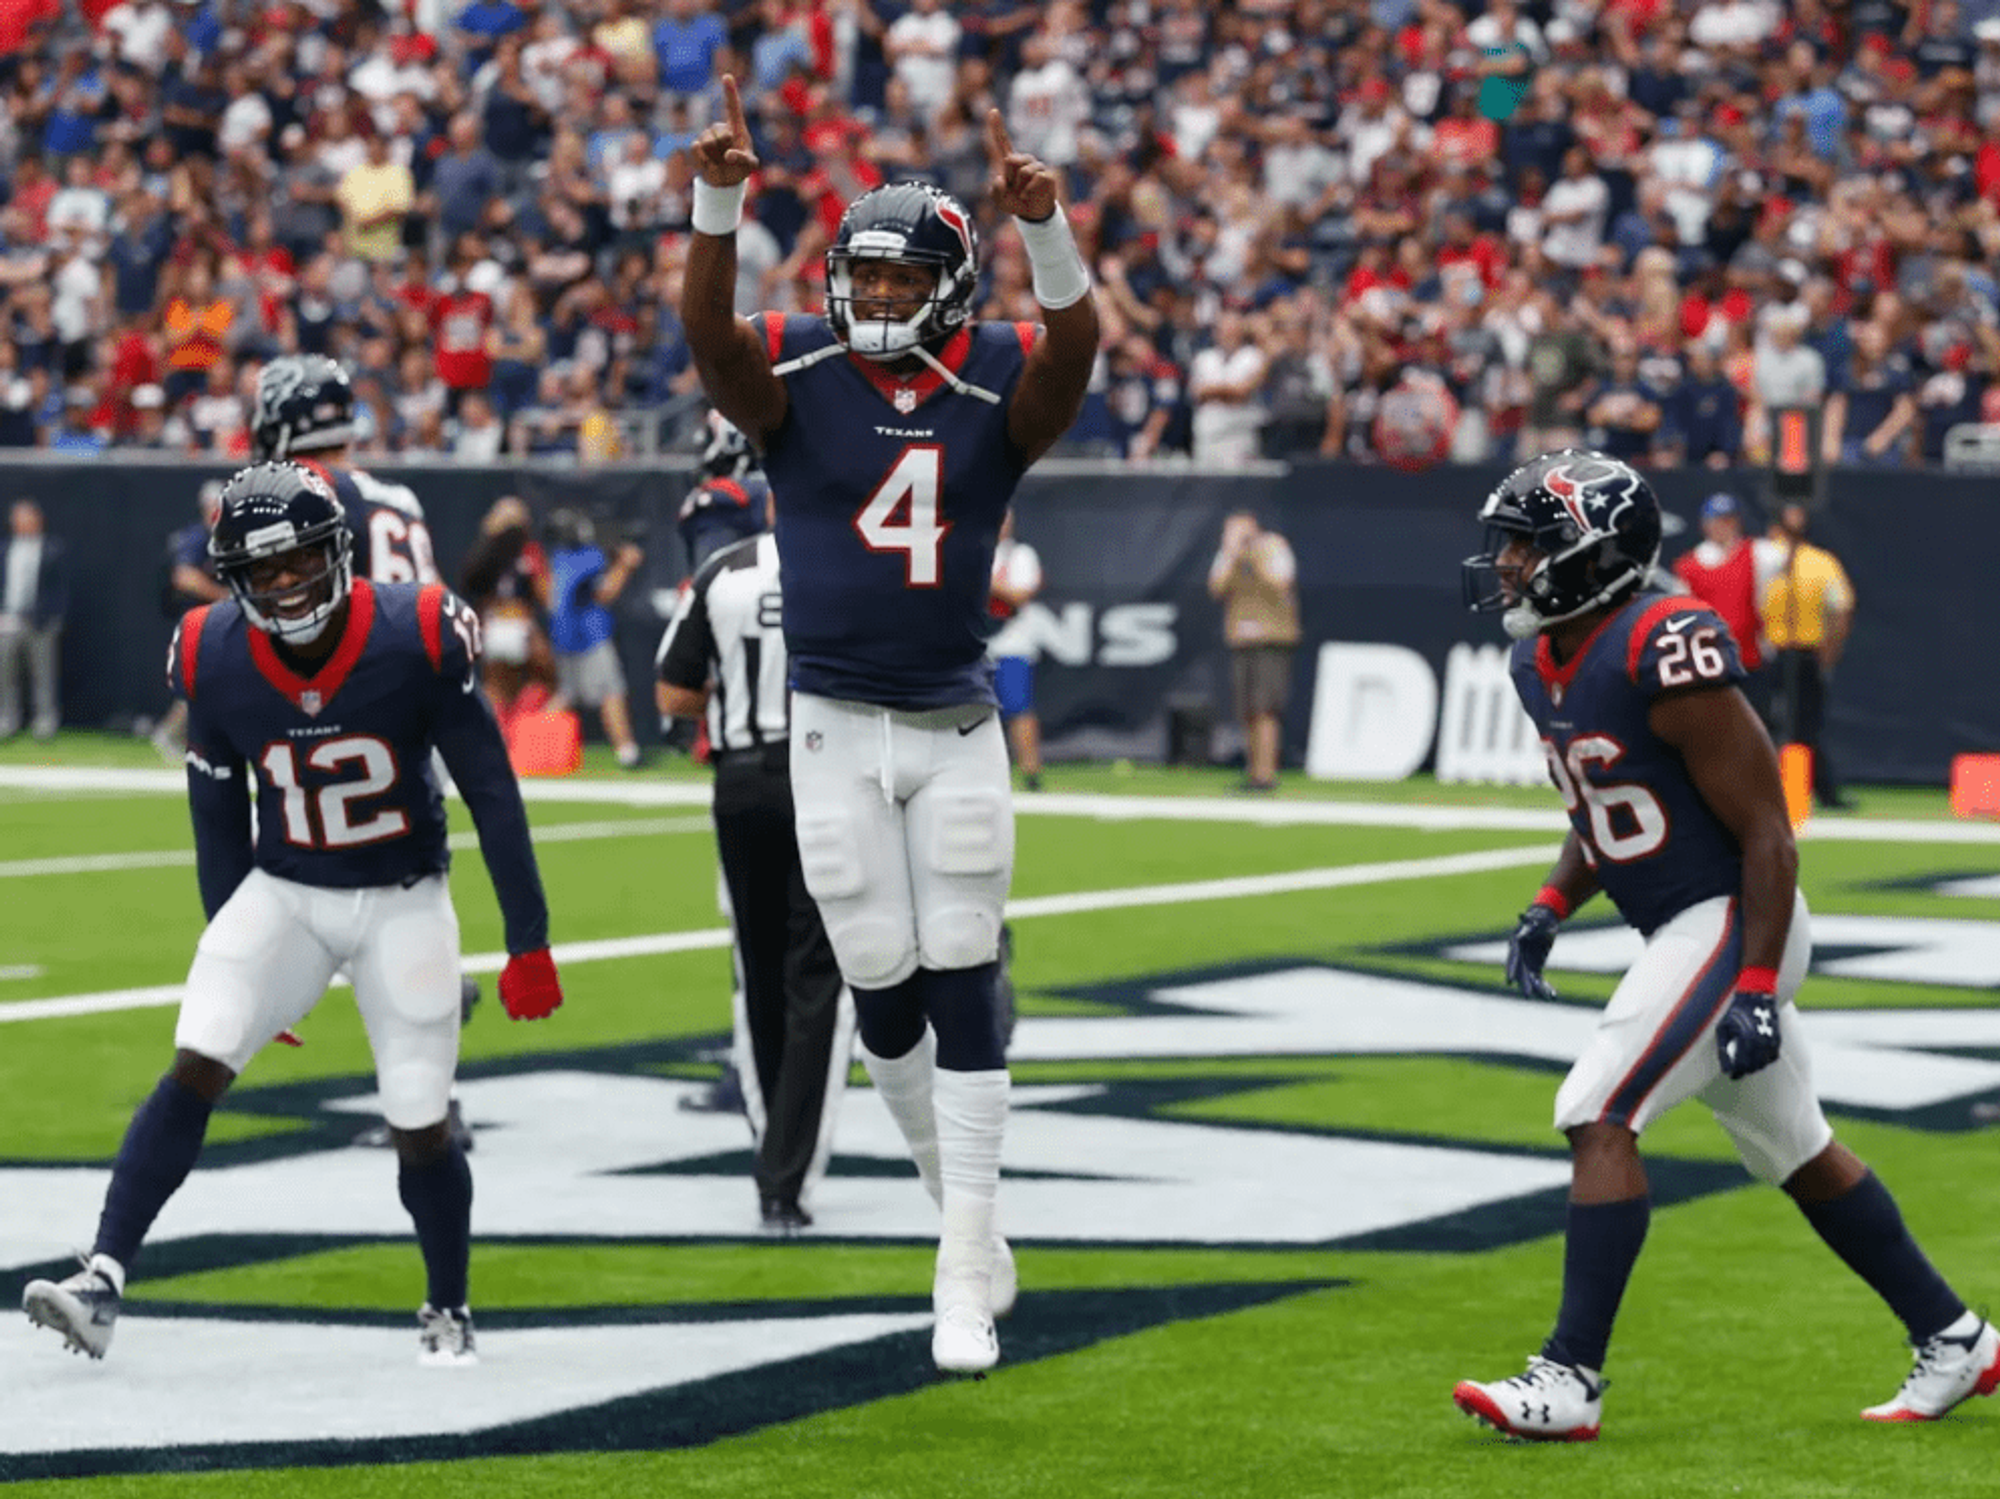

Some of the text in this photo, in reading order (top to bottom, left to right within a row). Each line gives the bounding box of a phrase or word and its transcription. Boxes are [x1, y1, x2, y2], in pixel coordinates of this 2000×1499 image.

[874, 426, 934, 437] TEXANS
[852, 443, 955, 588] 4
[1655, 627, 1725, 687] 26
[260, 734, 410, 847] 12
